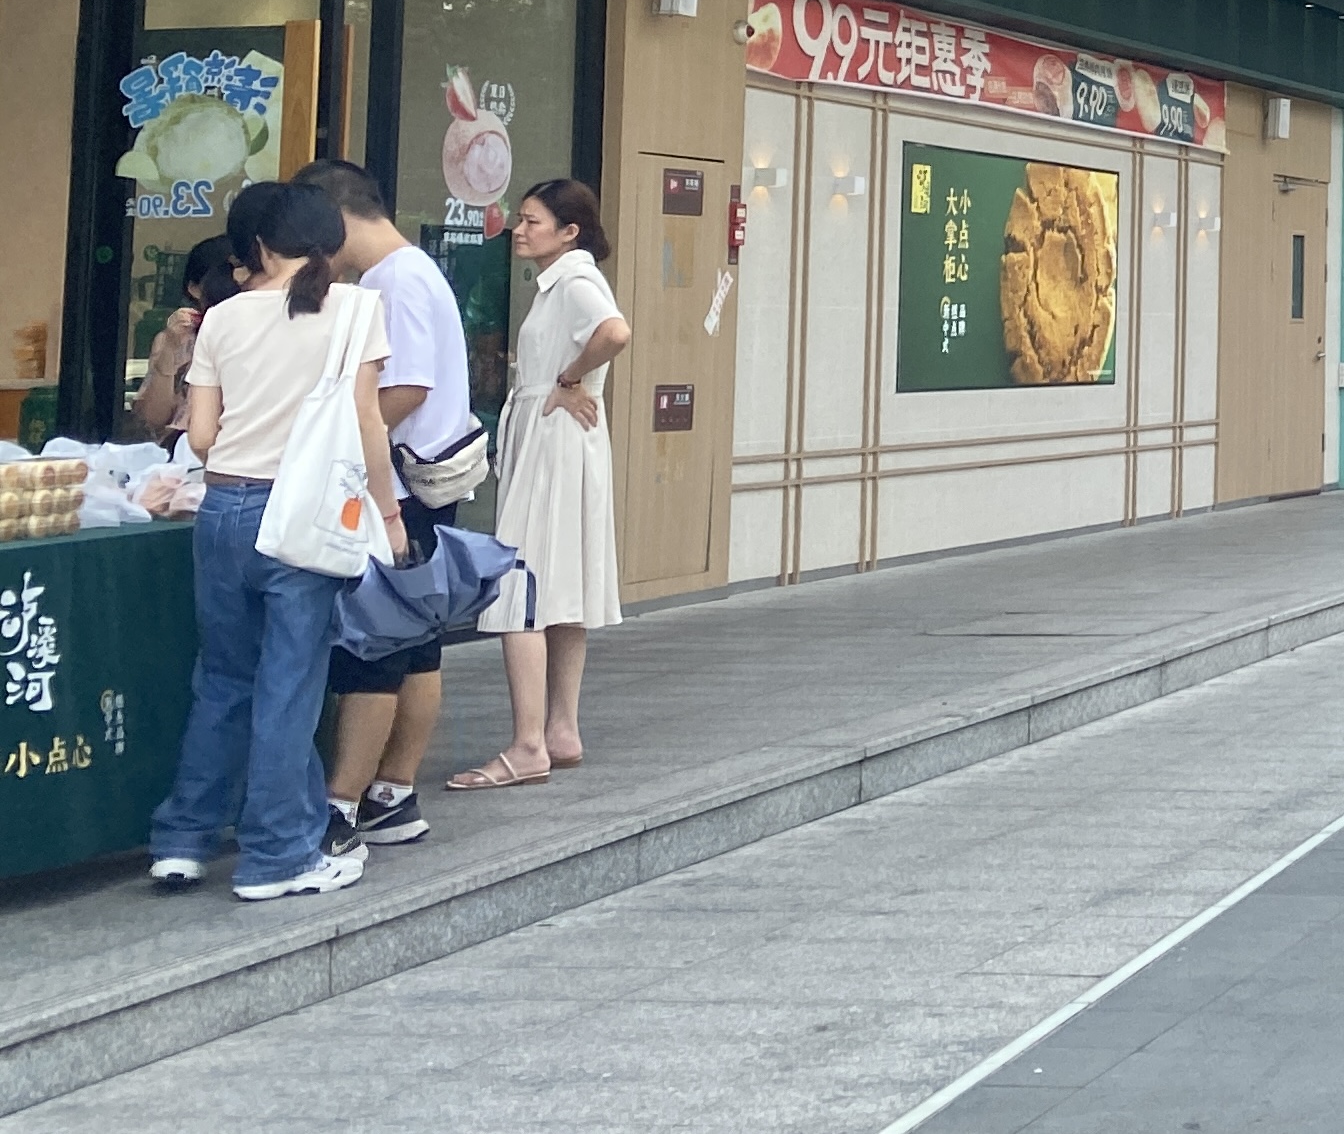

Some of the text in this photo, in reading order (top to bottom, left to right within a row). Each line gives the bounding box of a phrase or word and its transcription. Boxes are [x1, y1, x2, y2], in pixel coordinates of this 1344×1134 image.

[444, 197, 479, 227] 23.90
[956, 188, 972, 282] 小点心
[4, 734, 92, 778] 小点心
